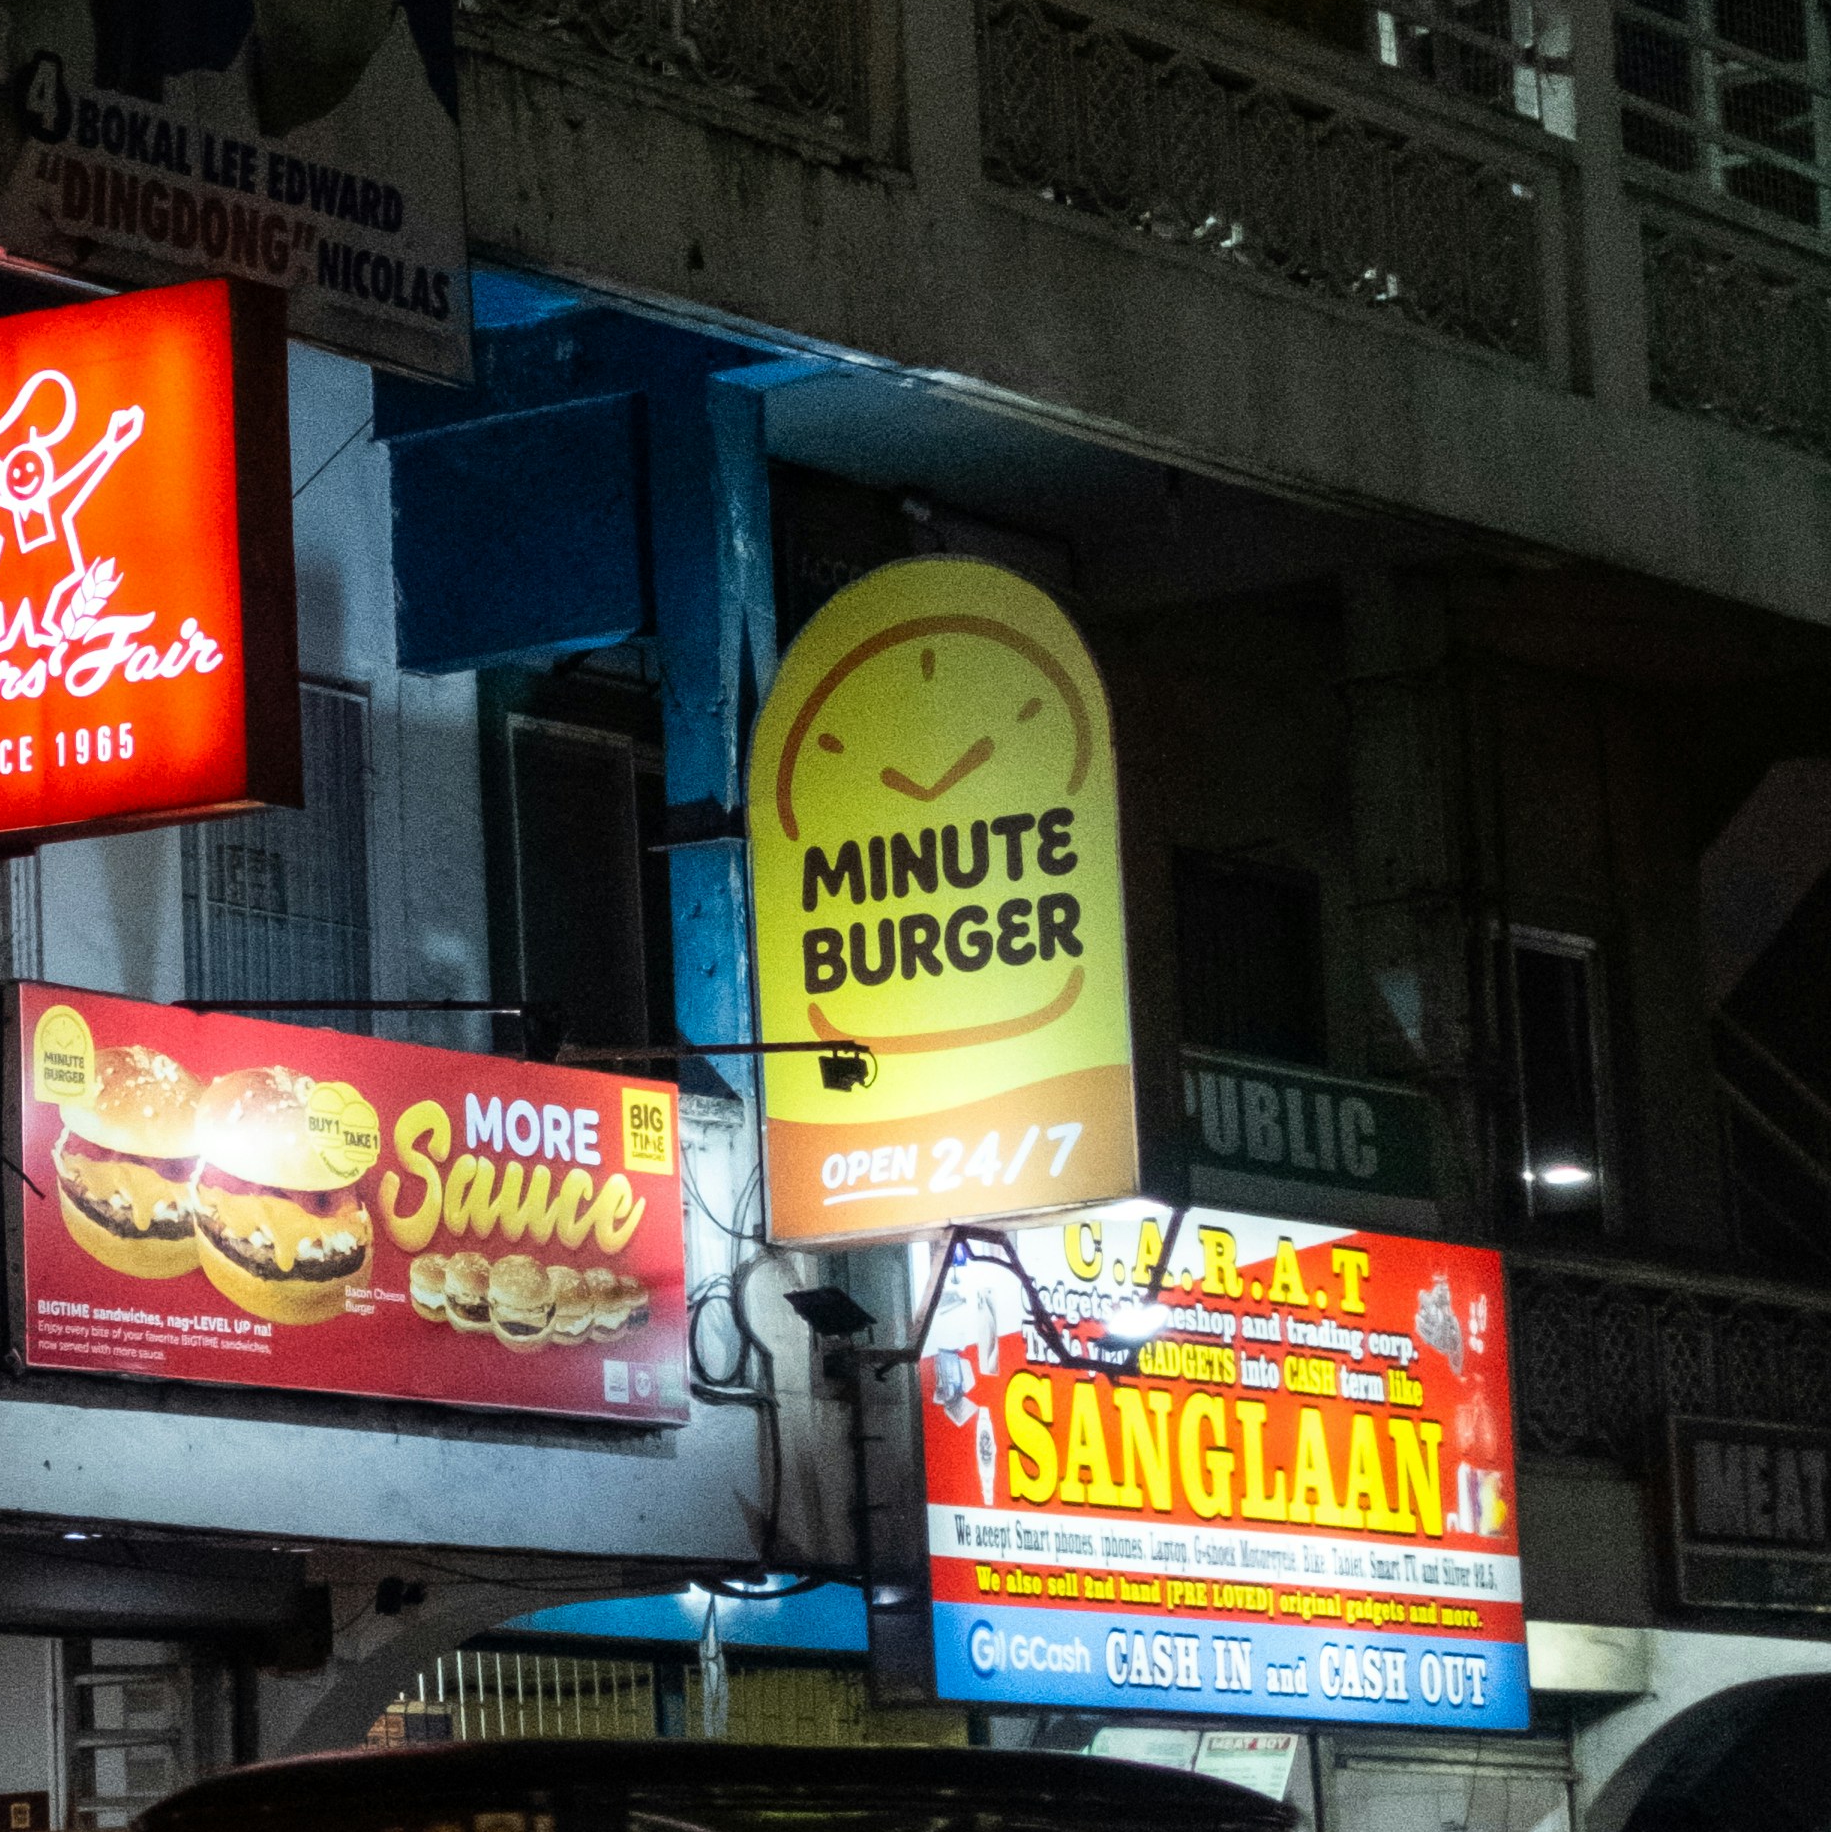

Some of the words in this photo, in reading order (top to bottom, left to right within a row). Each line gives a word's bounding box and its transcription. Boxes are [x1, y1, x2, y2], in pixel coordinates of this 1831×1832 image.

[25, 57, 60, 132] 4
[78, 101, 193, 172] BOKAL
[203, 131, 257, 191] LEE
[267, 153, 404, 234] EDWARD
[317, 247, 451, 322] NICOLAS
[65, 611, 224, 698] Fair
[55, 722, 135, 768] 1965
[802, 807, 1079, 913] MINUTE
[803, 892, 1083, 995] BURGER
[43, 1050, 85, 1070] MINUTE
[43, 1066, 86, 1085] BURGER
[308, 1115, 331, 1134] BUY
[343, 1130, 370, 1149] TAKE
[465, 1092, 602, 1166] MORE
[629, 1103, 665, 1132] BIG
[377, 1099, 646, 1255] Sauce
[822, 1142, 919, 1191] OPEN
[928, 1122, 1083, 1195] 24/7
[37, 1299, 90, 1319] BIGTIME
[167, 1315, 231, 1334] nag-LEVEL
[234, 1319, 251, 1335] UP
[254, 1322, 272, 1338] na!
[37, 1319, 63, 1336] Enjoy
[64, 1325, 90, 1338] every
[1241, 1310, 1282, 1343] and
[1286, 1315, 1364, 1360] trading
[1368, 1332, 1419, 1367] corp.
[1138, 1339, 1236, 1386] GADGETS
[1240, 1350, 1281, 1390] into
[1283, 1355, 1338, 1397] CASH
[1340, 1365, 1386, 1404] term
[1387, 1367, 1424, 1407] like
[1003, 1369, 1445, 1541] SANGLAAN
[953, 1513, 972, 1547] We
[974, 1525, 1012, 1559] accept
[1015, 1519, 1050, 1552] Smart
[1369, 1550, 1402, 1582] Smart
[975, 1563, 1002, 1594] We
[1006, 1569, 1044, 1596] also
[1047, 1572, 1080, 1599] sell
[1083, 1574, 1116, 1602] 2nd
[1119, 1576, 1162, 1606] hand
[1166, 1578, 1209, 1611] [PRE
[1211, 1581, 1276, 1618] LOVED]
[1279, 1590, 1342, 1623] original
[1346, 1594, 1407, 1629] gadgets
[1409, 1600, 1438, 1626] and
[1440, 1607, 1485, 1630] more.
[1010, 1633, 1092, 1674] GCash
[1105, 1627, 1202, 1690] CASH
[1213, 1635, 1253, 1693] IN
[1266, 1656, 1310, 1697] and
[1318, 1642, 1409, 1702] CASH
[1419, 1648, 1487, 1708] OUT
